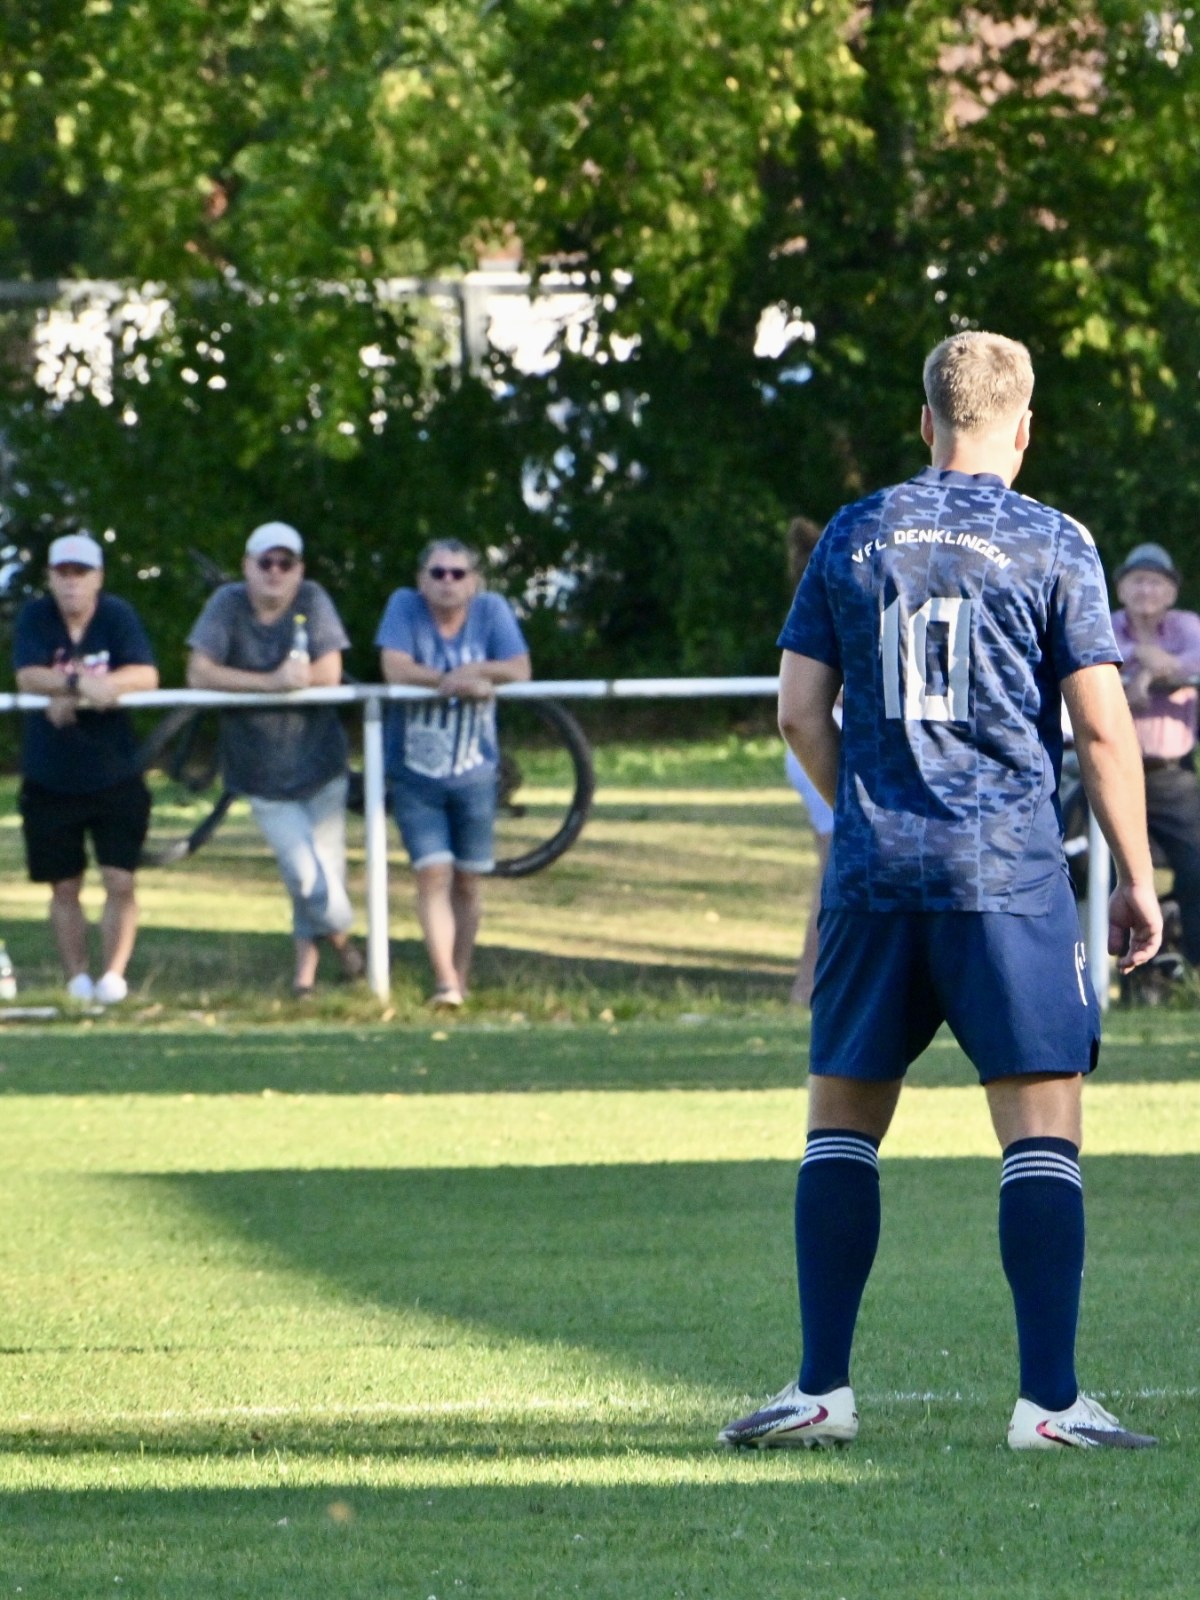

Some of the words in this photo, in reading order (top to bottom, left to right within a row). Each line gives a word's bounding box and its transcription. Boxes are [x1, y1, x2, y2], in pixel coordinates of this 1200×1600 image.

[851, 538, 887, 564] VFL
[894, 529, 1011, 570] DENKLINGEN
[880, 595, 972, 721] 10
